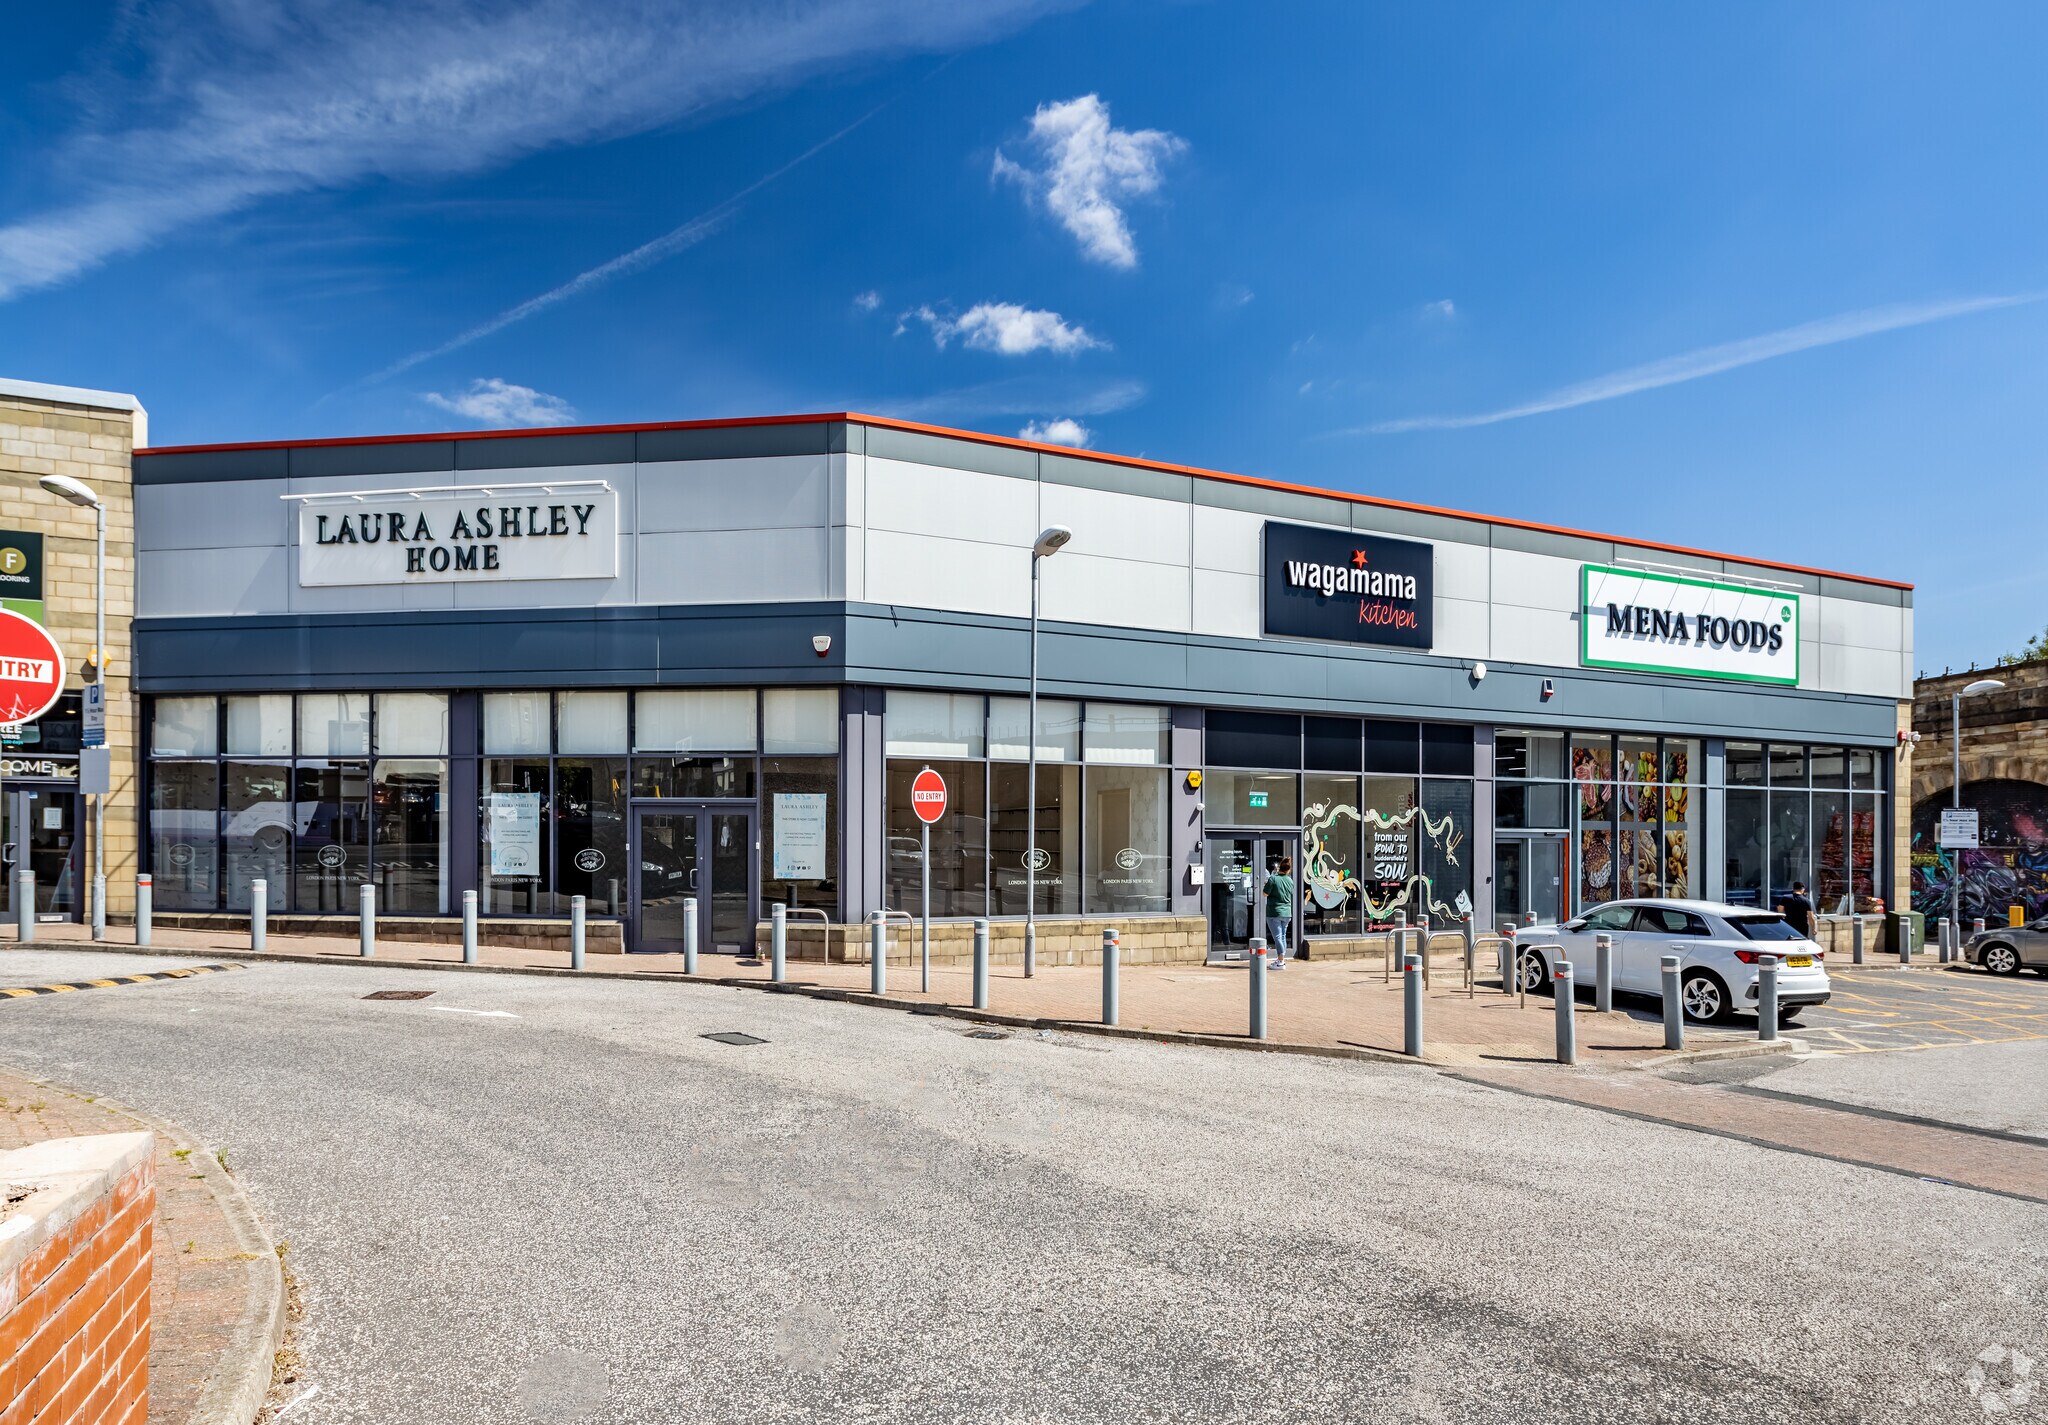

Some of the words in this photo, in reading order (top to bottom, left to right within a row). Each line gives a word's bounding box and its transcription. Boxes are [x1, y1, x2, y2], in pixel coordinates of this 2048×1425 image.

[316, 511, 434, 545] LAURA
[450, 504, 596, 540] ASHLEY
[6, 553, 17, 569] F
[405, 545, 500, 573] HOME
[0, 575, 30, 583] OORING
[1285, 560, 1417, 600] wagamama
[1606, 602, 1691, 640] MENA
[1696, 613, 1783, 651] FOODS
[1374, 832, 1393, 841] from
[1374, 862, 1408, 880] SOUL
